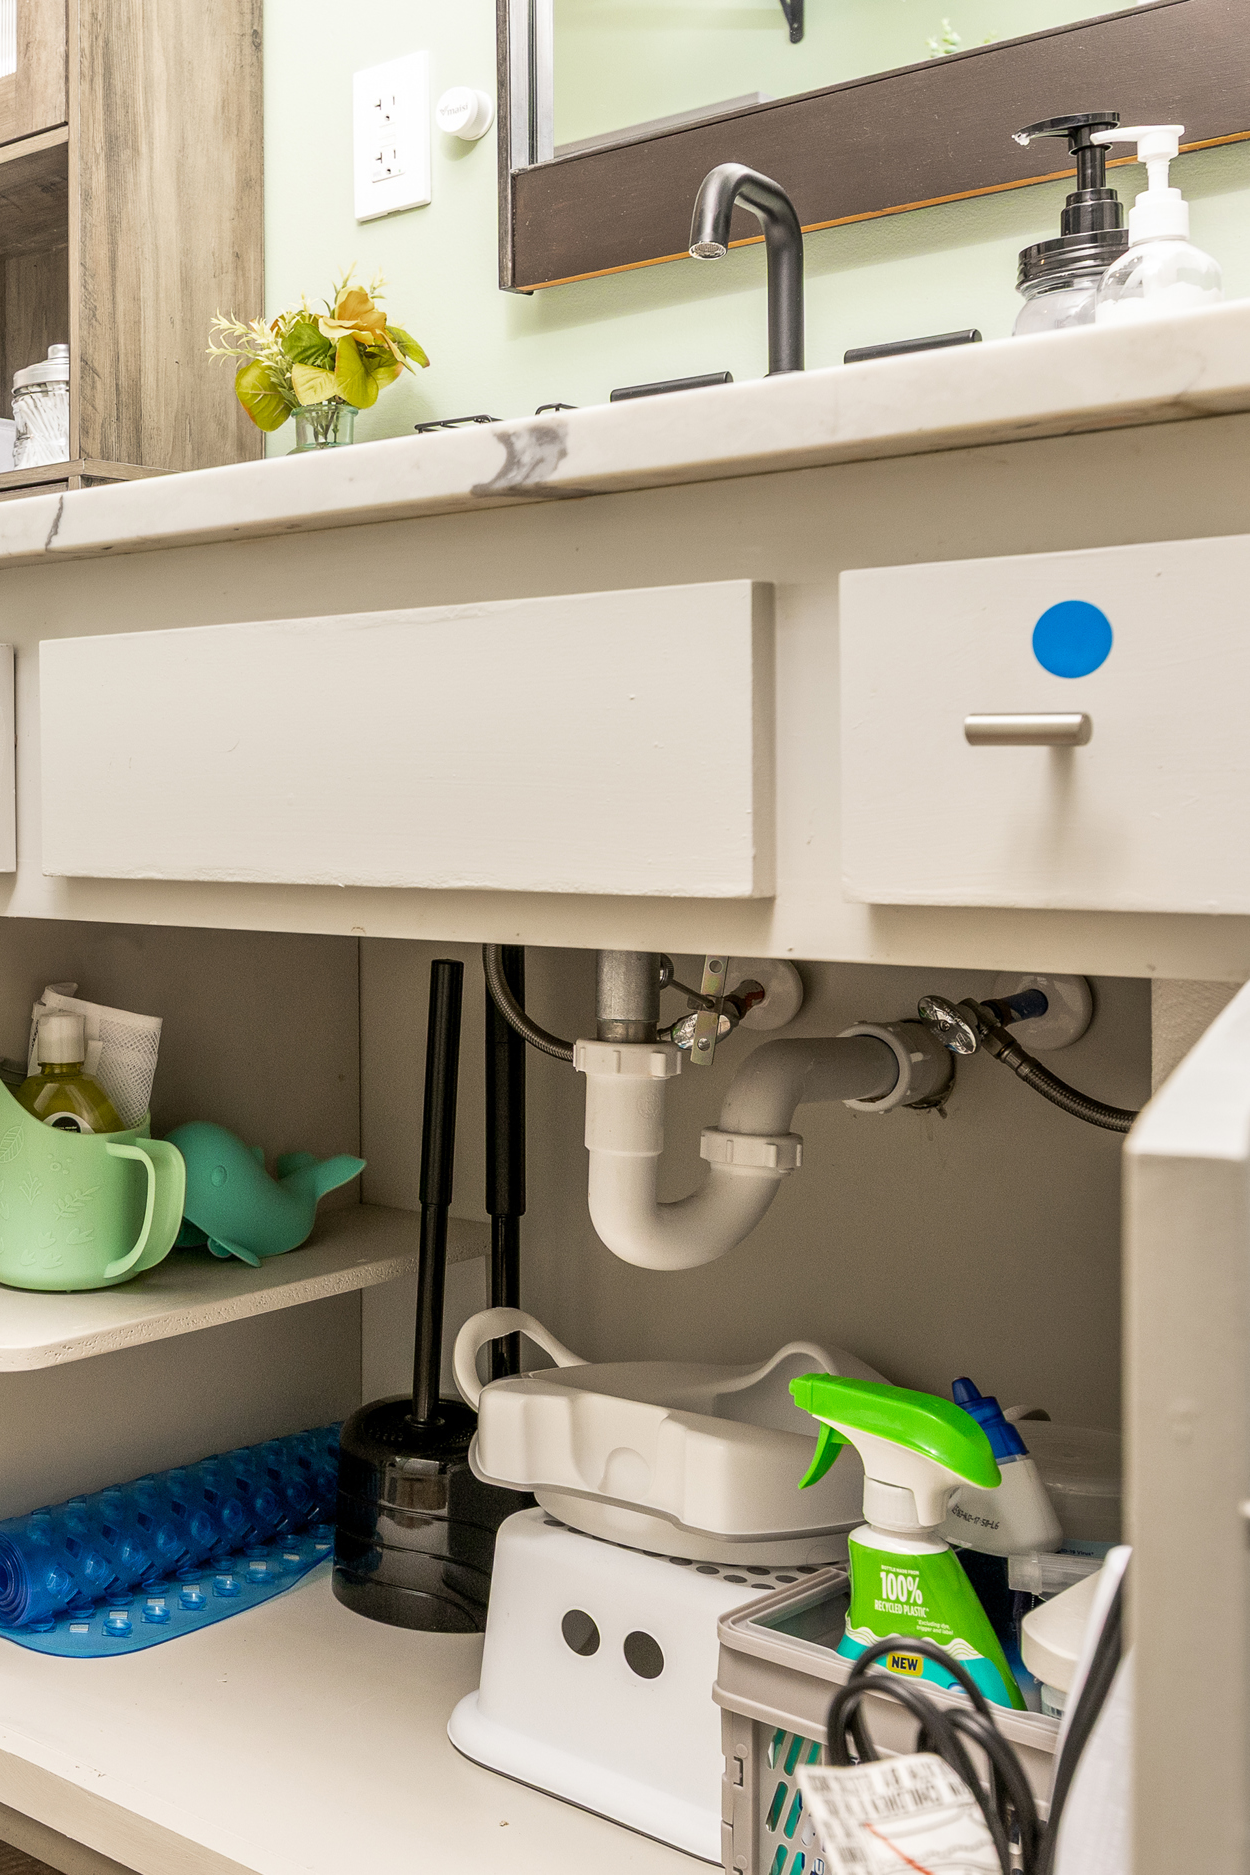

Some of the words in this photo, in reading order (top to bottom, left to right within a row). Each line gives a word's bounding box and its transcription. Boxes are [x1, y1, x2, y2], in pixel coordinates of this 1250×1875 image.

[880, 1571, 924, 1605] 100%
[874, 1599, 903, 1614] RECYCLED
[891, 1655, 919, 1672] NEW
